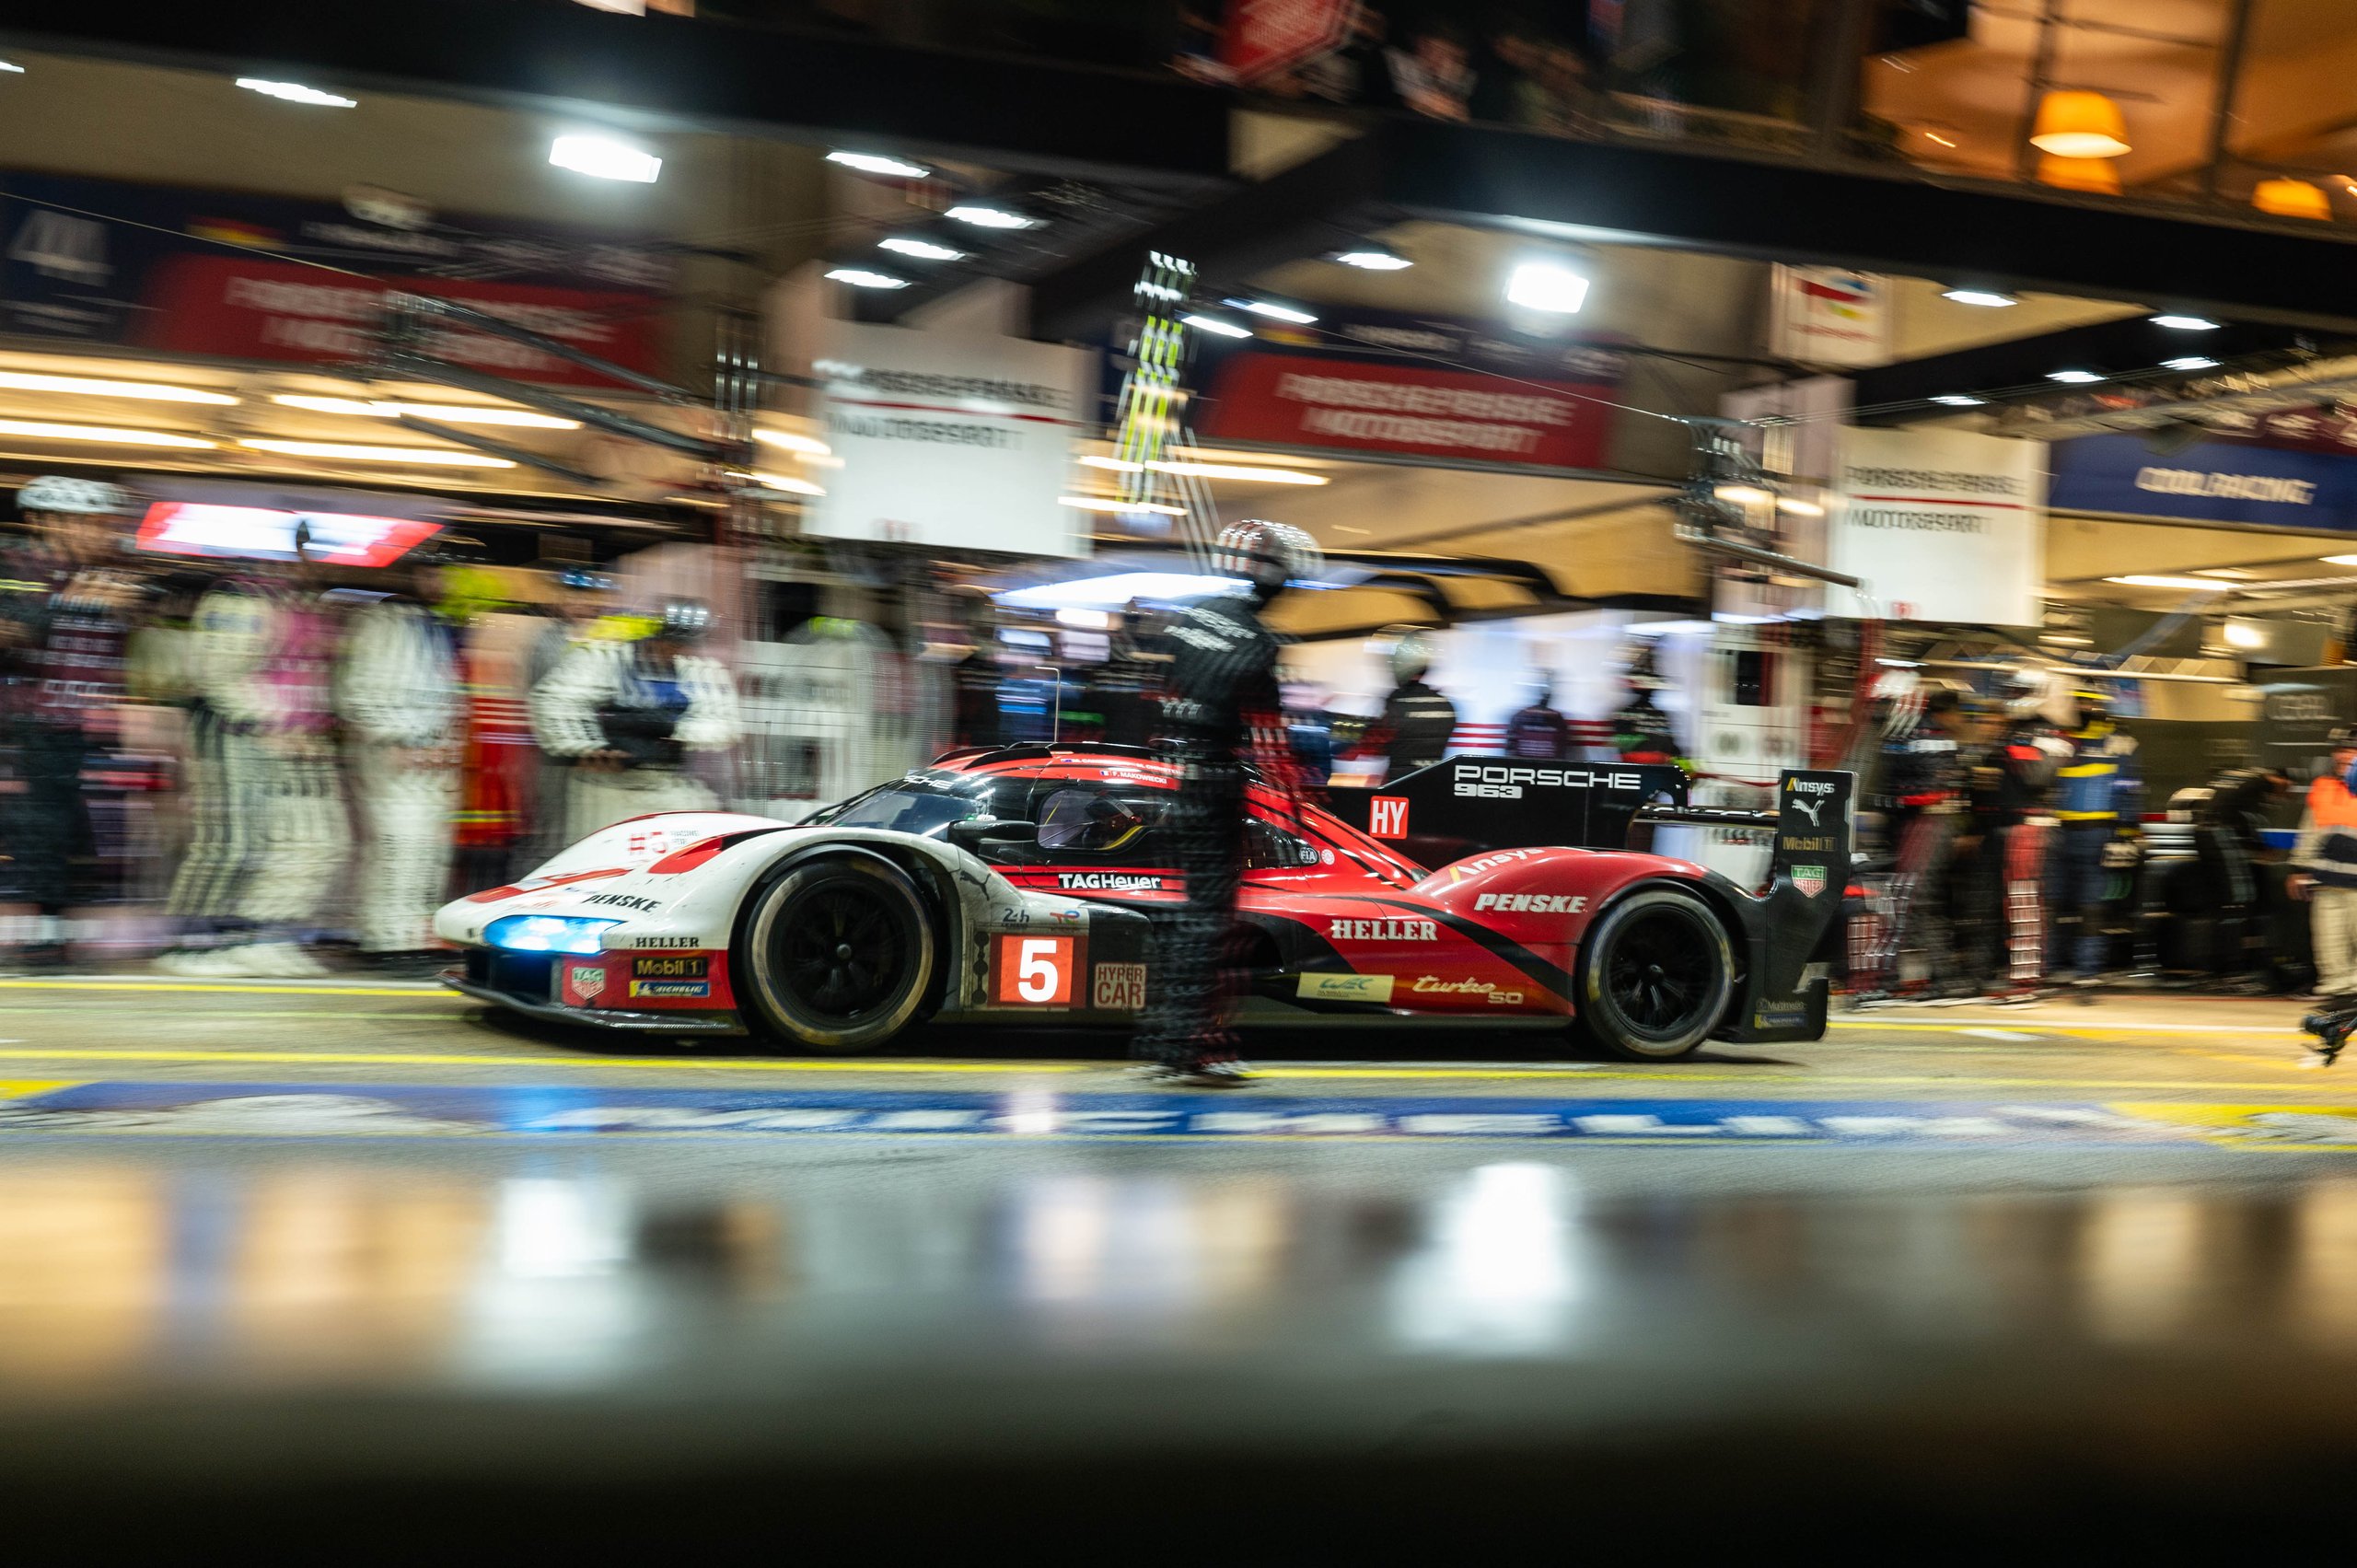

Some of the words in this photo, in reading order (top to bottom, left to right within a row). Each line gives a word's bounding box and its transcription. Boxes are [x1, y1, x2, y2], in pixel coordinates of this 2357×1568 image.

[1454, 765, 1642, 790] PORSCHE
[1454, 784, 1523, 799] 963
[1372, 800, 1407, 834] HY
[1782, 836, 1820, 851] Mobil
[1300, 850, 1316, 862] FIA
[1794, 867, 1821, 878] TAG
[581, 894, 662, 913] PENSKE
[1474, 893, 1588, 913] PENSKE
[1331, 919, 1437, 940] HELLER
[635, 936, 700, 947] HELLER
[637, 959, 684, 975] Mobil
[1017, 939, 1058, 1003] 5
[1098, 967, 1143, 981] HYPER
[1412, 975, 1496, 993] turbo
[1097, 982, 1142, 1005] CAR
[1488, 992, 1524, 1005] 50
